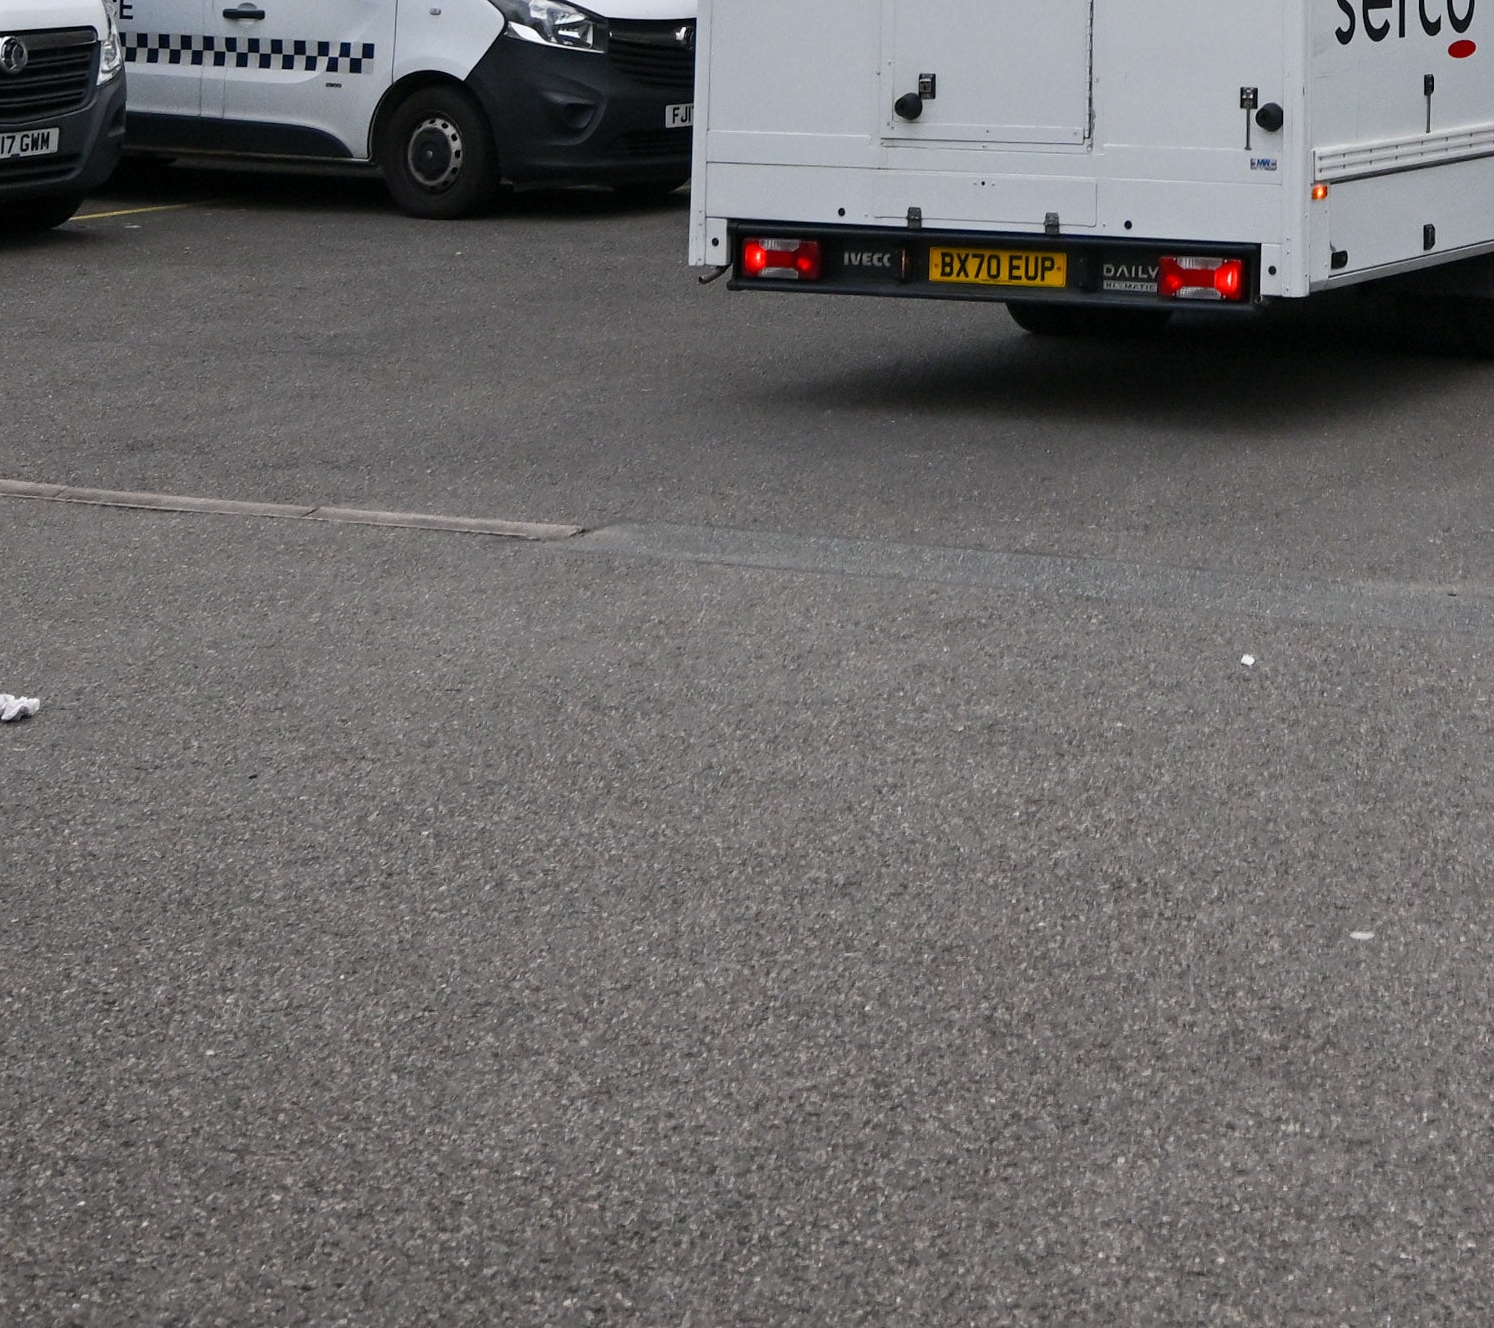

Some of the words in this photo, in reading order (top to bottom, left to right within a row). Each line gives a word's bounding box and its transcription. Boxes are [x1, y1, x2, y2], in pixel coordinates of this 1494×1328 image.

[672, 105, 694, 124] FJ1
[940, 252, 1001, 279] BX70
[1008, 255, 1055, 281] EUP
[1103, 264, 1159, 279] DAILY
